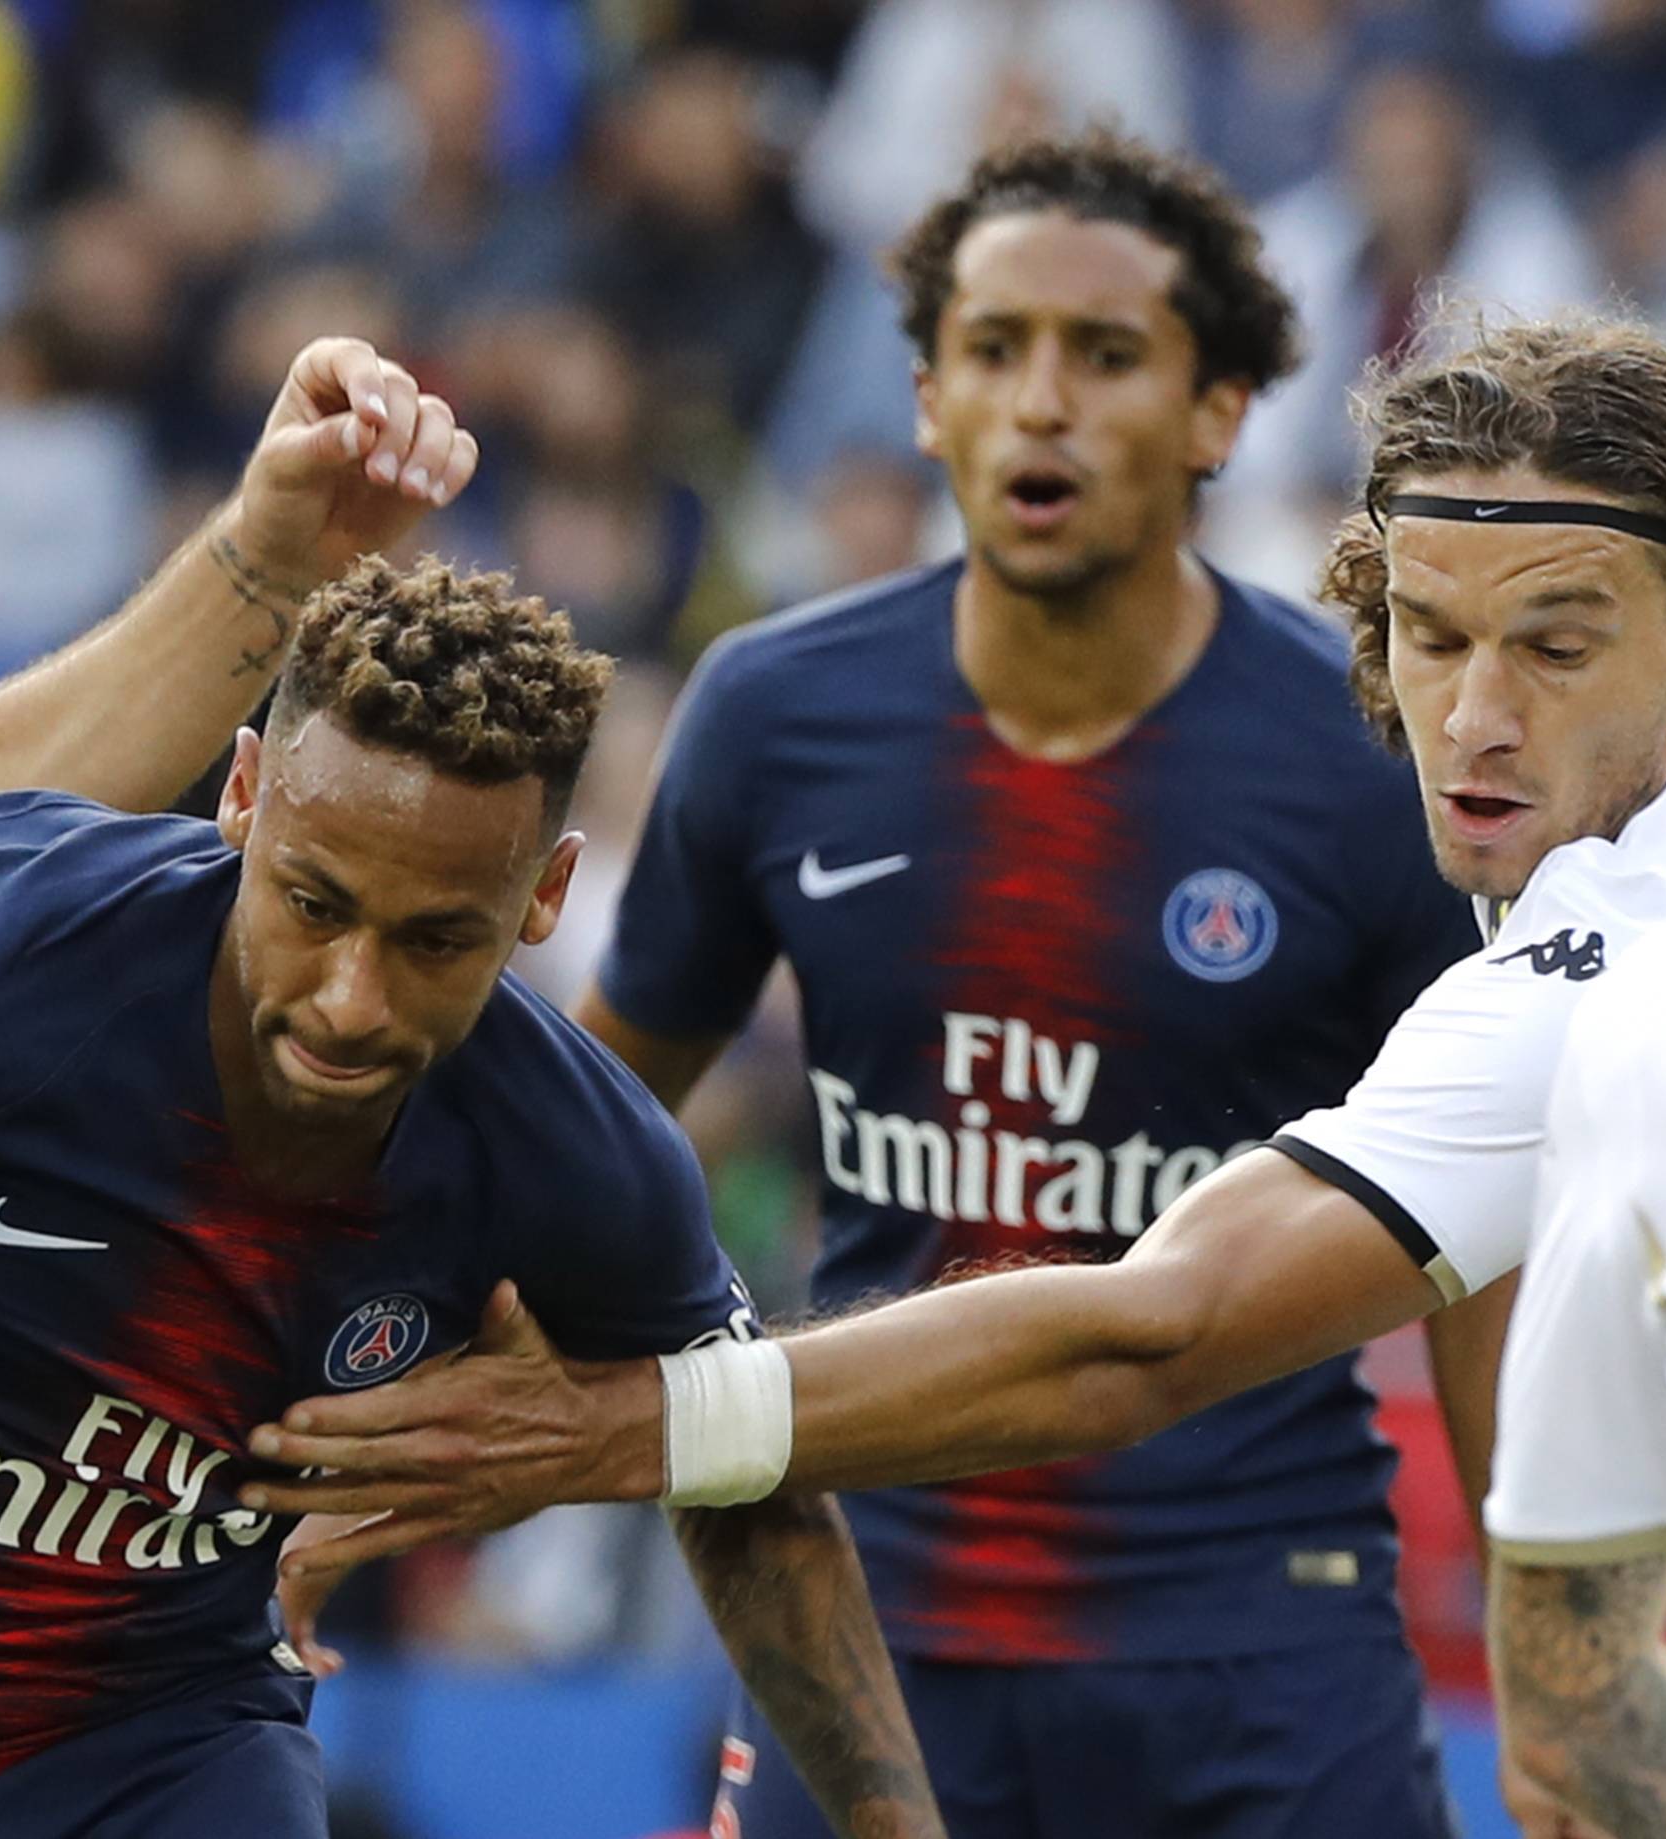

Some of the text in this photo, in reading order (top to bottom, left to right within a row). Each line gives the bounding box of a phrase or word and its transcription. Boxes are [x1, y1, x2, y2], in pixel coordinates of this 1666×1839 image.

[942, 1010, 1100, 1127] Fly
[809, 1068, 1263, 1237] Emirate
[62, 1393, 231, 1517] Fly
